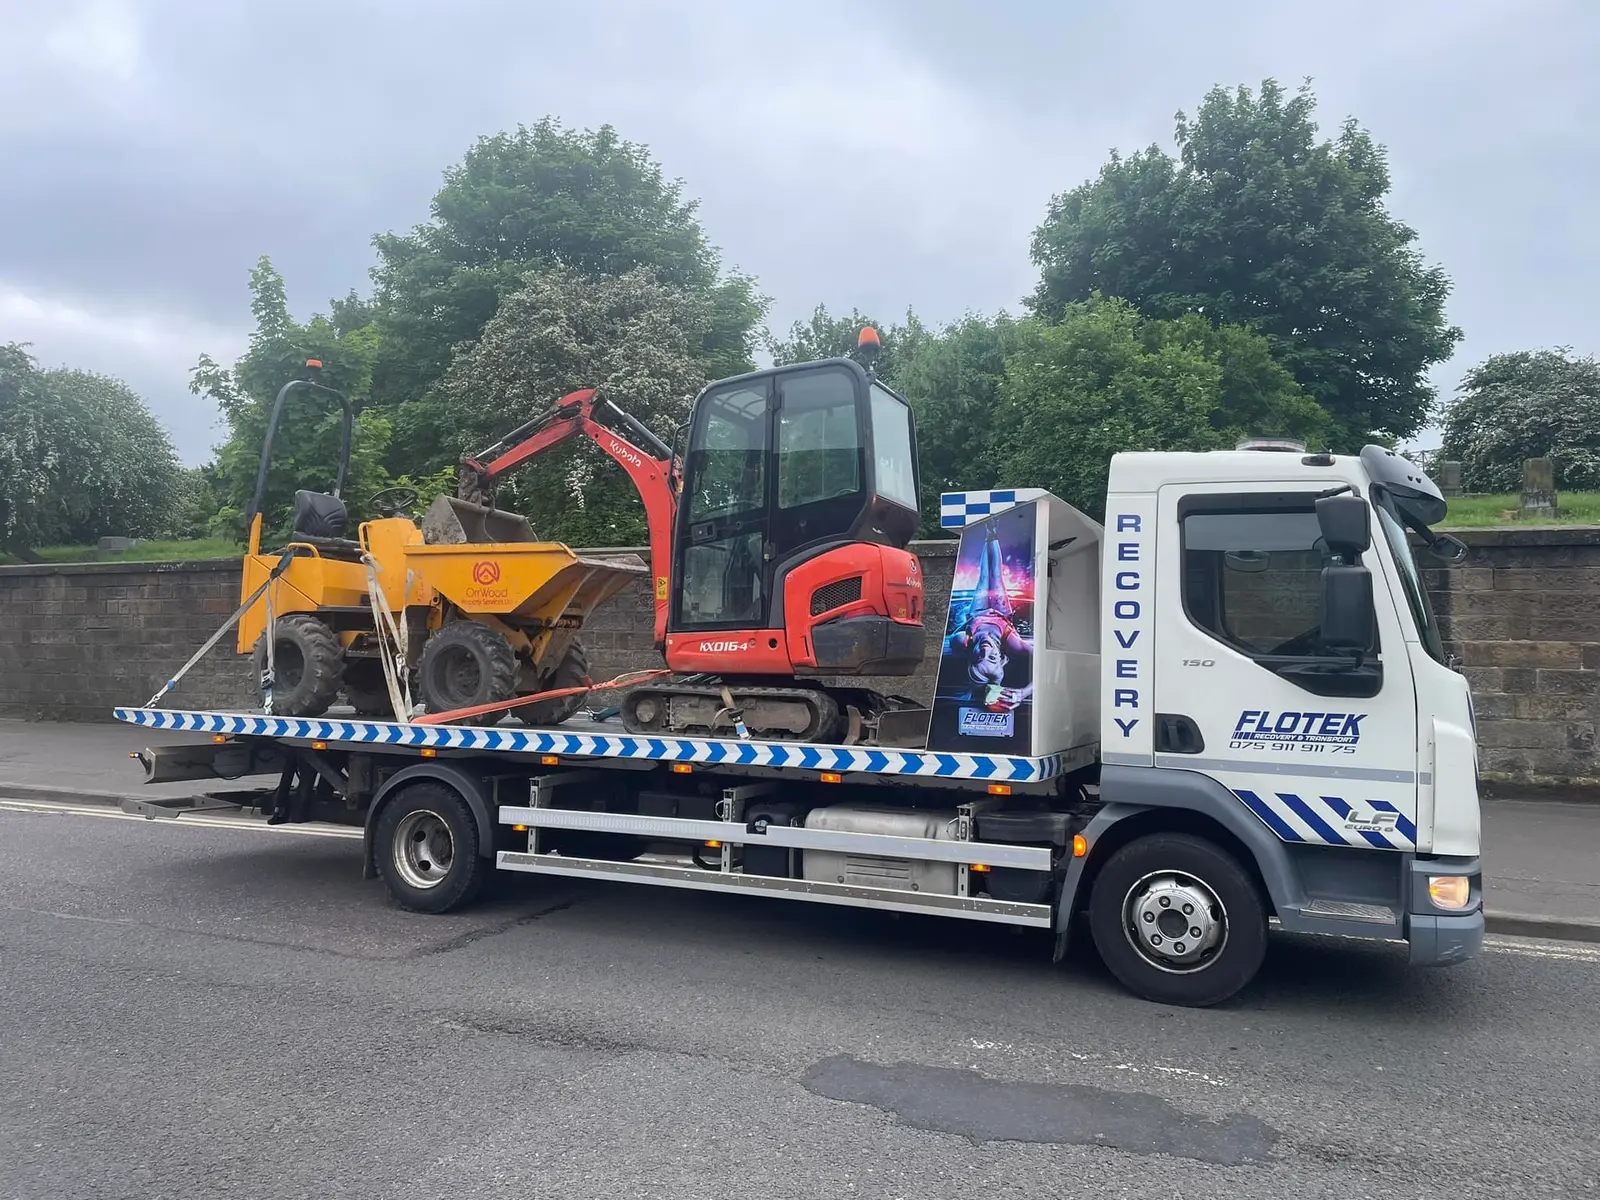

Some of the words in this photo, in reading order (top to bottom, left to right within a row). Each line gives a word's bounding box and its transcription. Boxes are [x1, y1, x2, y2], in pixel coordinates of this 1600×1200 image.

[610, 440, 642, 467] Kubota
[1113, 514, 1142, 738] RECOVERY
[699, 641, 749, 652] KX016-4
[1181, 659, 1216, 667] 150
[963, 713, 1010, 724] FLOTEK
[1234, 710, 1368, 736] FLOTEK
[1254, 733, 1297, 742] RECOVERY
[1305, 735, 1355, 743] TRANSPORT
[1229, 741, 1266, 750] 075
[1271, 742, 1295, 752] 911
[1301, 743, 1325, 753] 911
[1331, 745, 1357, 754] 75
[1348, 811, 1399, 825] LF
[1344, 824, 1382, 832] EURO
